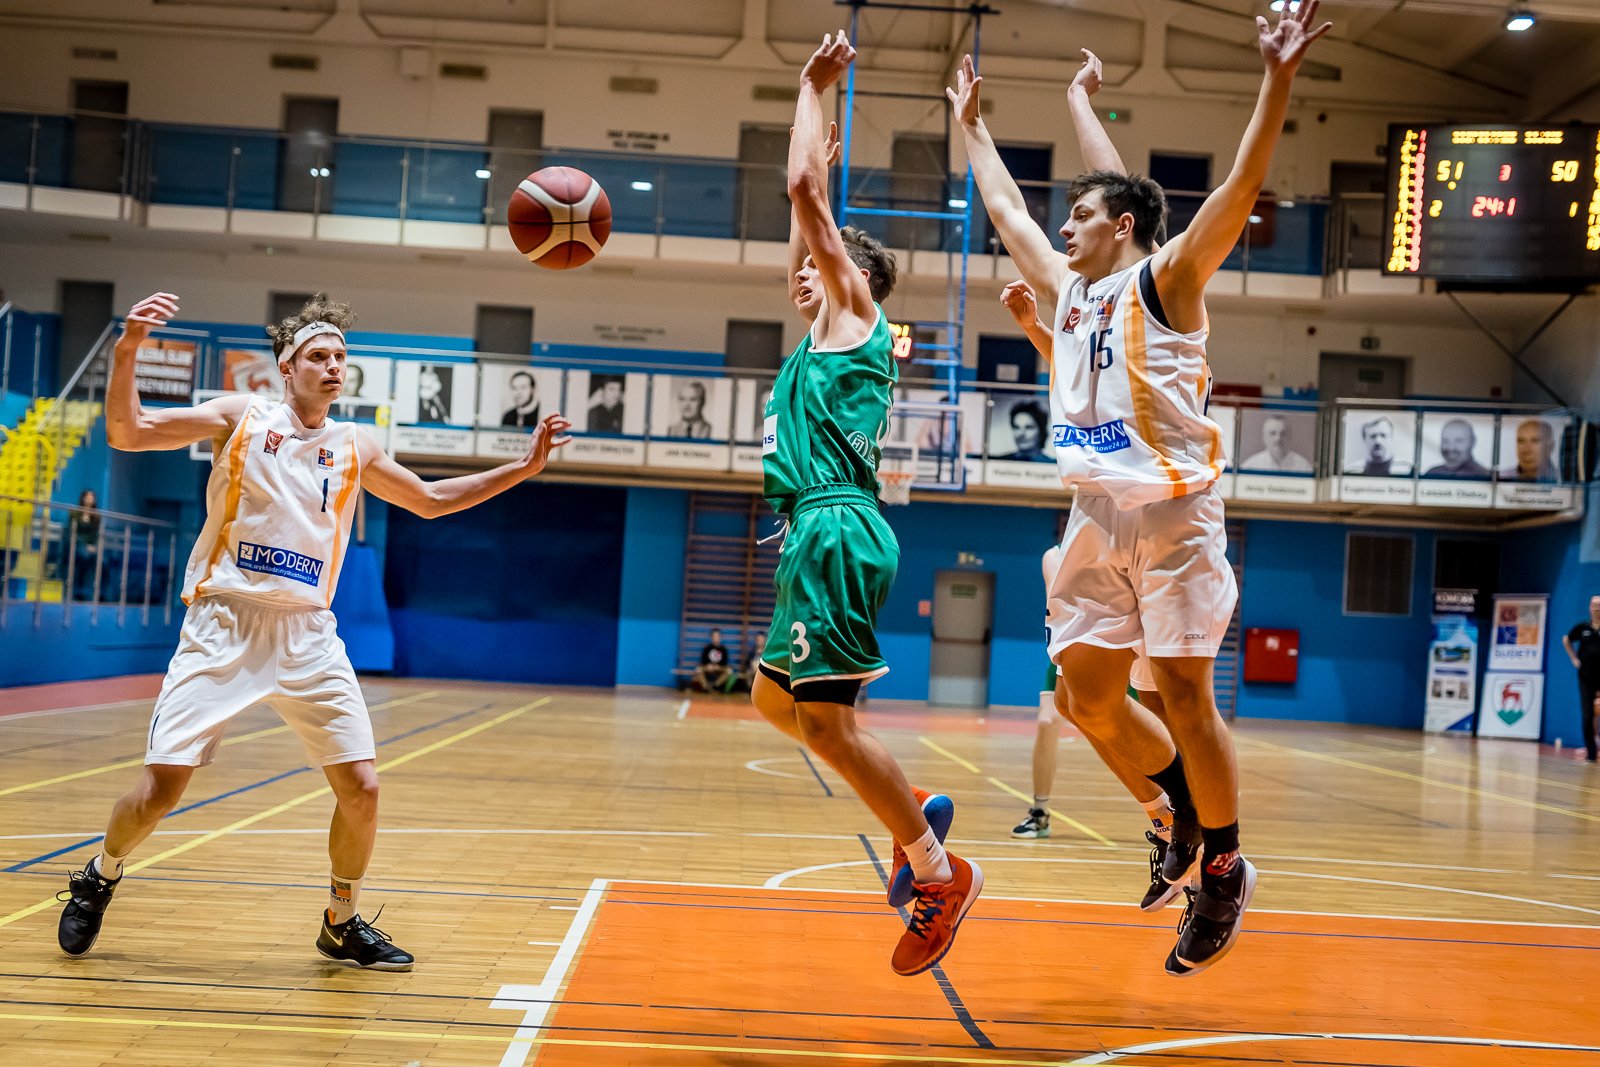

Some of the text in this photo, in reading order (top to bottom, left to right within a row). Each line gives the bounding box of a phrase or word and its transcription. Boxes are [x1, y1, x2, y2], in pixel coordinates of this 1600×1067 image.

[1499, 165, 1512, 181] 3
[1551, 160, 1579, 182] 50
[1429, 200, 1443, 217] 2
[1089, 327, 1113, 372] 15
[321, 477, 329, 512] 1
[255, 547, 322, 577] MODERN
[790, 621, 811, 663] 3
[1495, 649, 1538, 660] SUDETY
